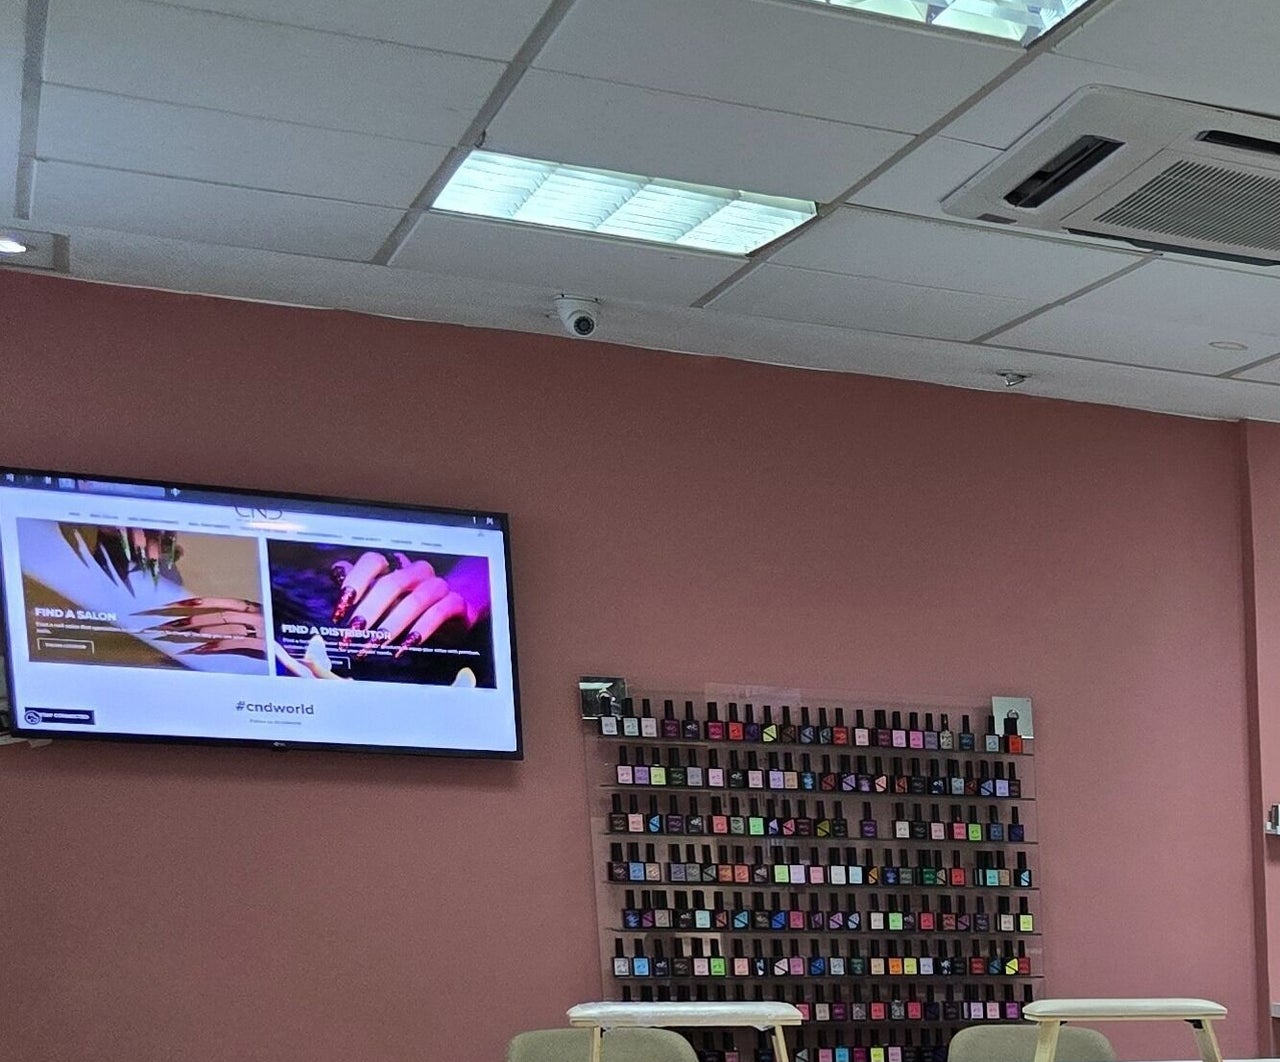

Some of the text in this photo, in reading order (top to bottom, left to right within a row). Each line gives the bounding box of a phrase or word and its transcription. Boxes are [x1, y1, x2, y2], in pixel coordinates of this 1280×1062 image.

[35, 607, 65, 618] FIND
[76, 610, 117, 622] SALON
[281, 624, 308, 635] FIND
[320, 627, 392, 641] DISTRIBUTOR
[236, 700, 314, 715] #cndworld
